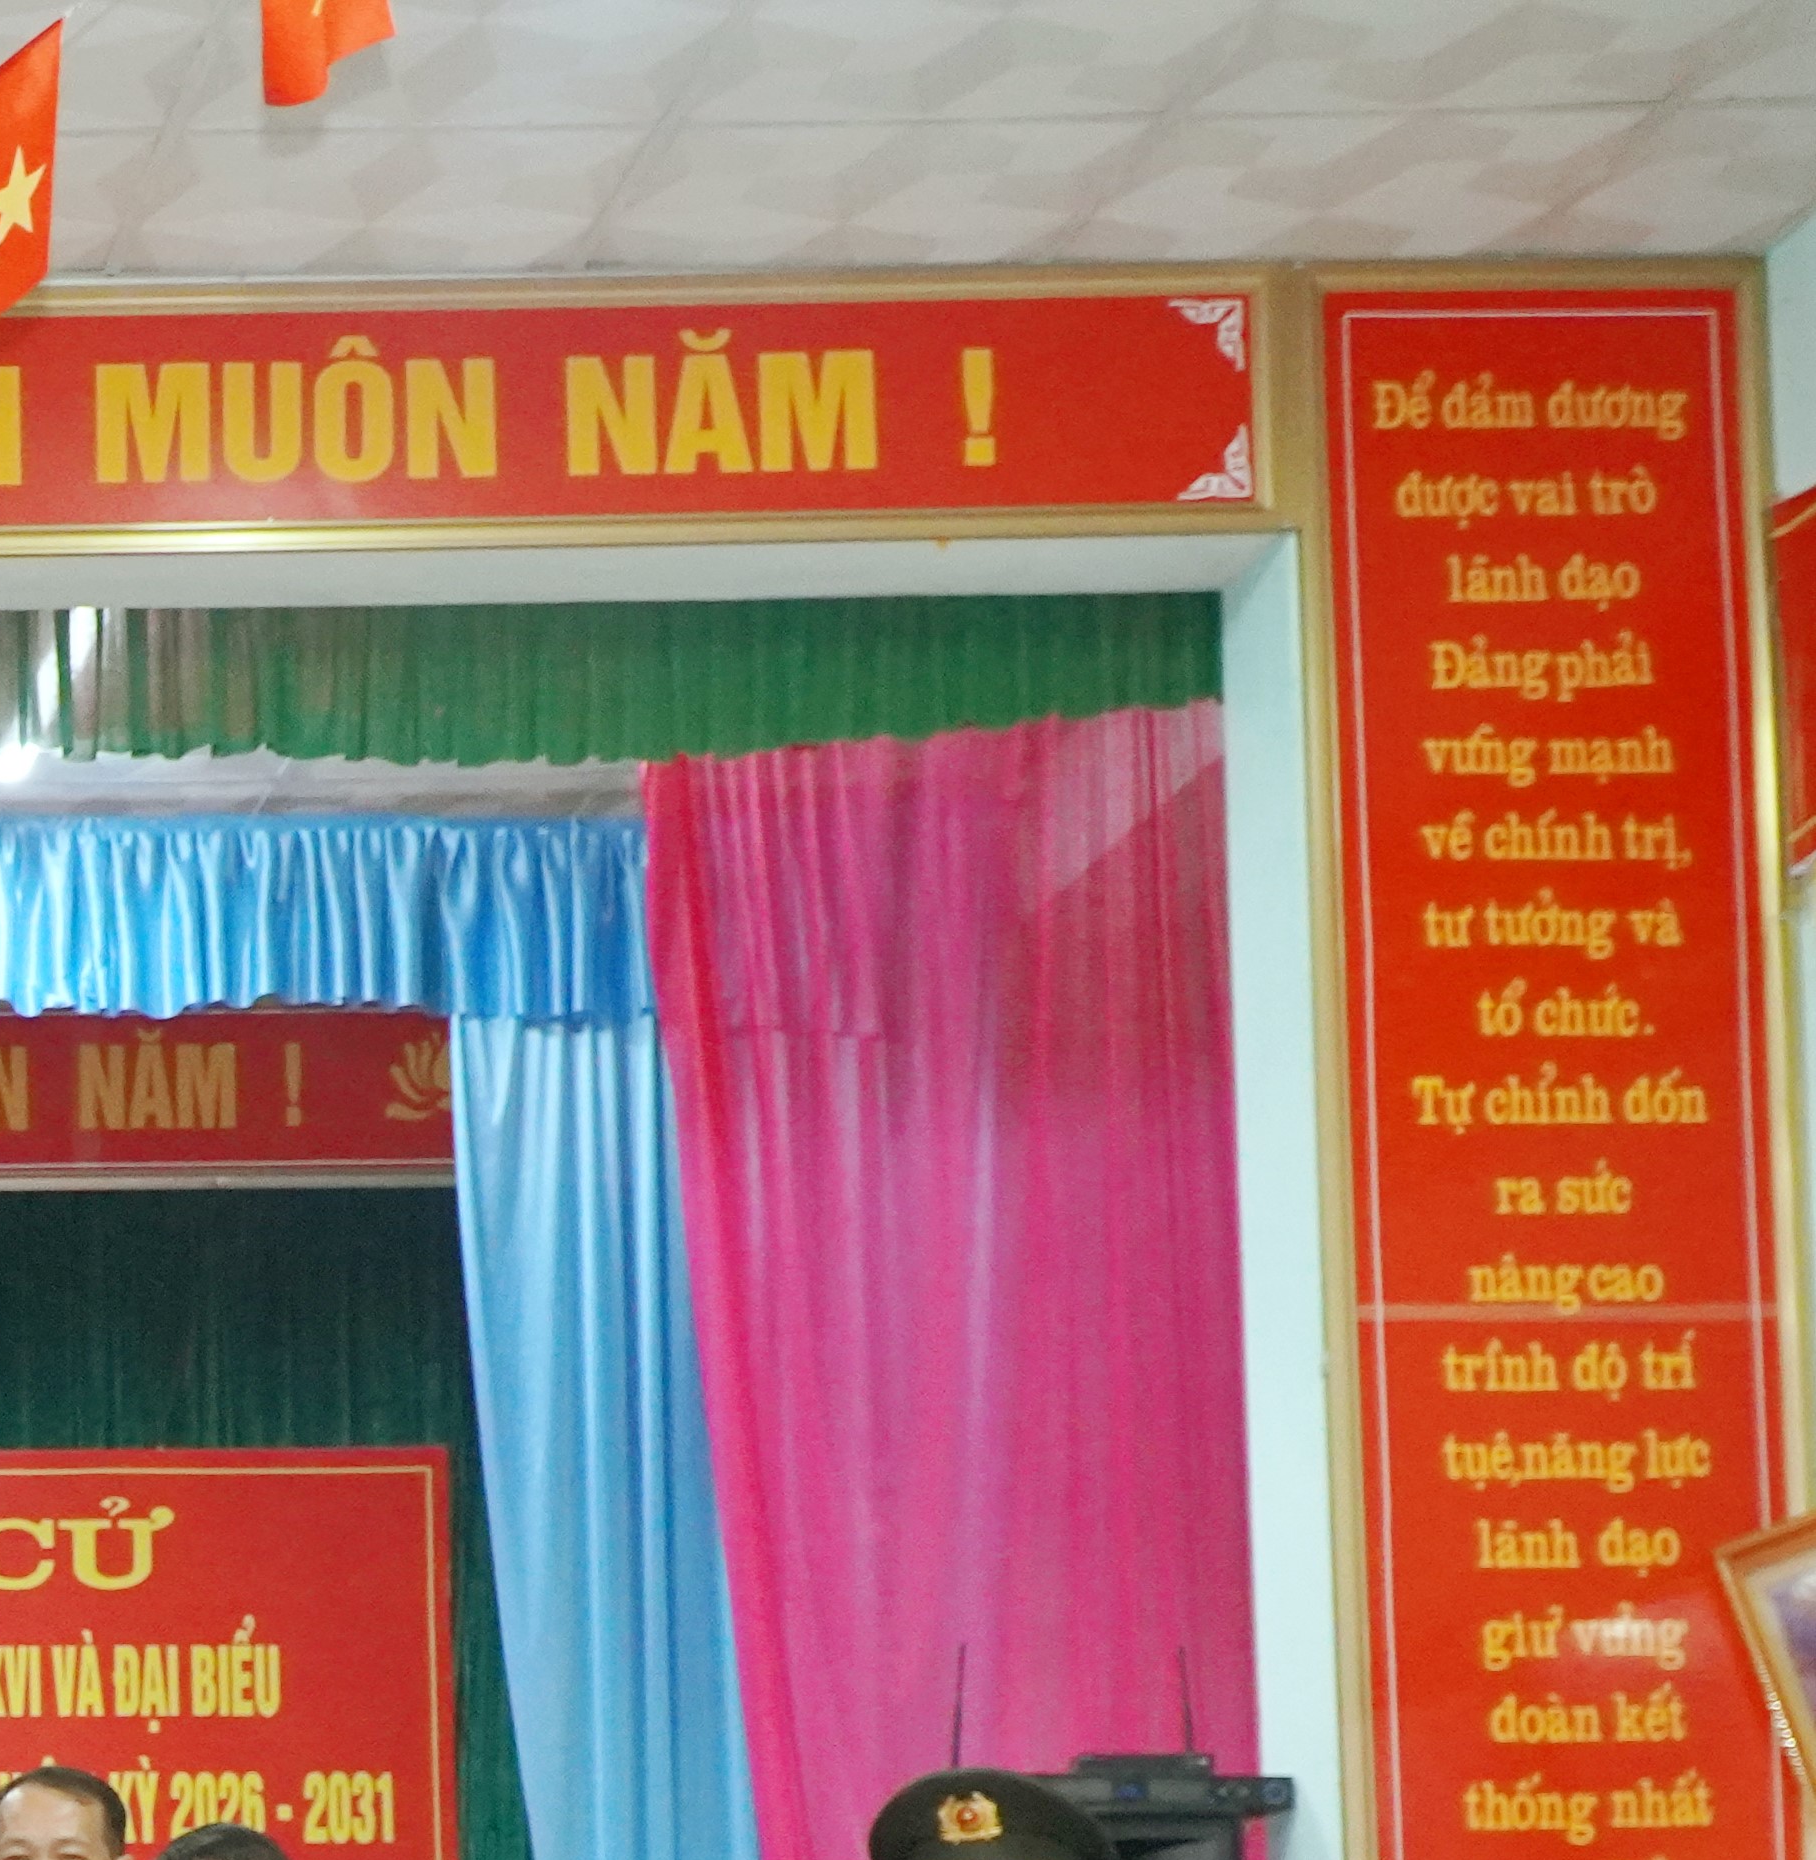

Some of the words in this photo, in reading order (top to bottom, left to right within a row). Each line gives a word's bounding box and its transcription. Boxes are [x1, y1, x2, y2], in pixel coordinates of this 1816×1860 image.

[94, 335, 498, 484] MUÔN
[565, 329, 877, 477] NĂM
[963, 349, 995, 466] !
[1395, 471, 1498, 529] được
[1508, 472, 1577, 516] vai
[1558, 554, 1640, 611] đạo
[1429, 632, 1549, 699] Đảng
[1558, 630, 1654, 700] phải
[1547, 726, 1673, 783] mạnh
[1483, 808, 1613, 860] chính
[77, 1030, 236, 1131] NĂM
[285, 1043, 301, 1126] !
[1410, 1075, 1477, 1135] Tự
[1483, 1061, 1614, 1125] chỉnh
[1493, 1176, 1547, 1216] ra
[1553, 1157, 1633, 1215] sức
[1588, 1263, 1664, 1302] cao
[1567, 1340, 1630, 1402] độ
[1637, 1328, 1697, 1391] trí
[1641, 1428, 1712, 1489] lực
[1594, 1516, 1681, 1578] đạo
[52, 1630, 104, 1717] VÀ
[113, 1645, 179, 1733] ĐẠI
[191, 1616, 279, 1716] BIỂU
[1486, 1691, 1604, 1744] đoàn
[1609, 1680, 1688, 1743] kết
[170, 1771, 266, 1841] 2026
[304, 1772, 393, 1843] 2031
[1460, 1771, 1601, 1846] thống
[1607, 1768, 1715, 1829] nhất
